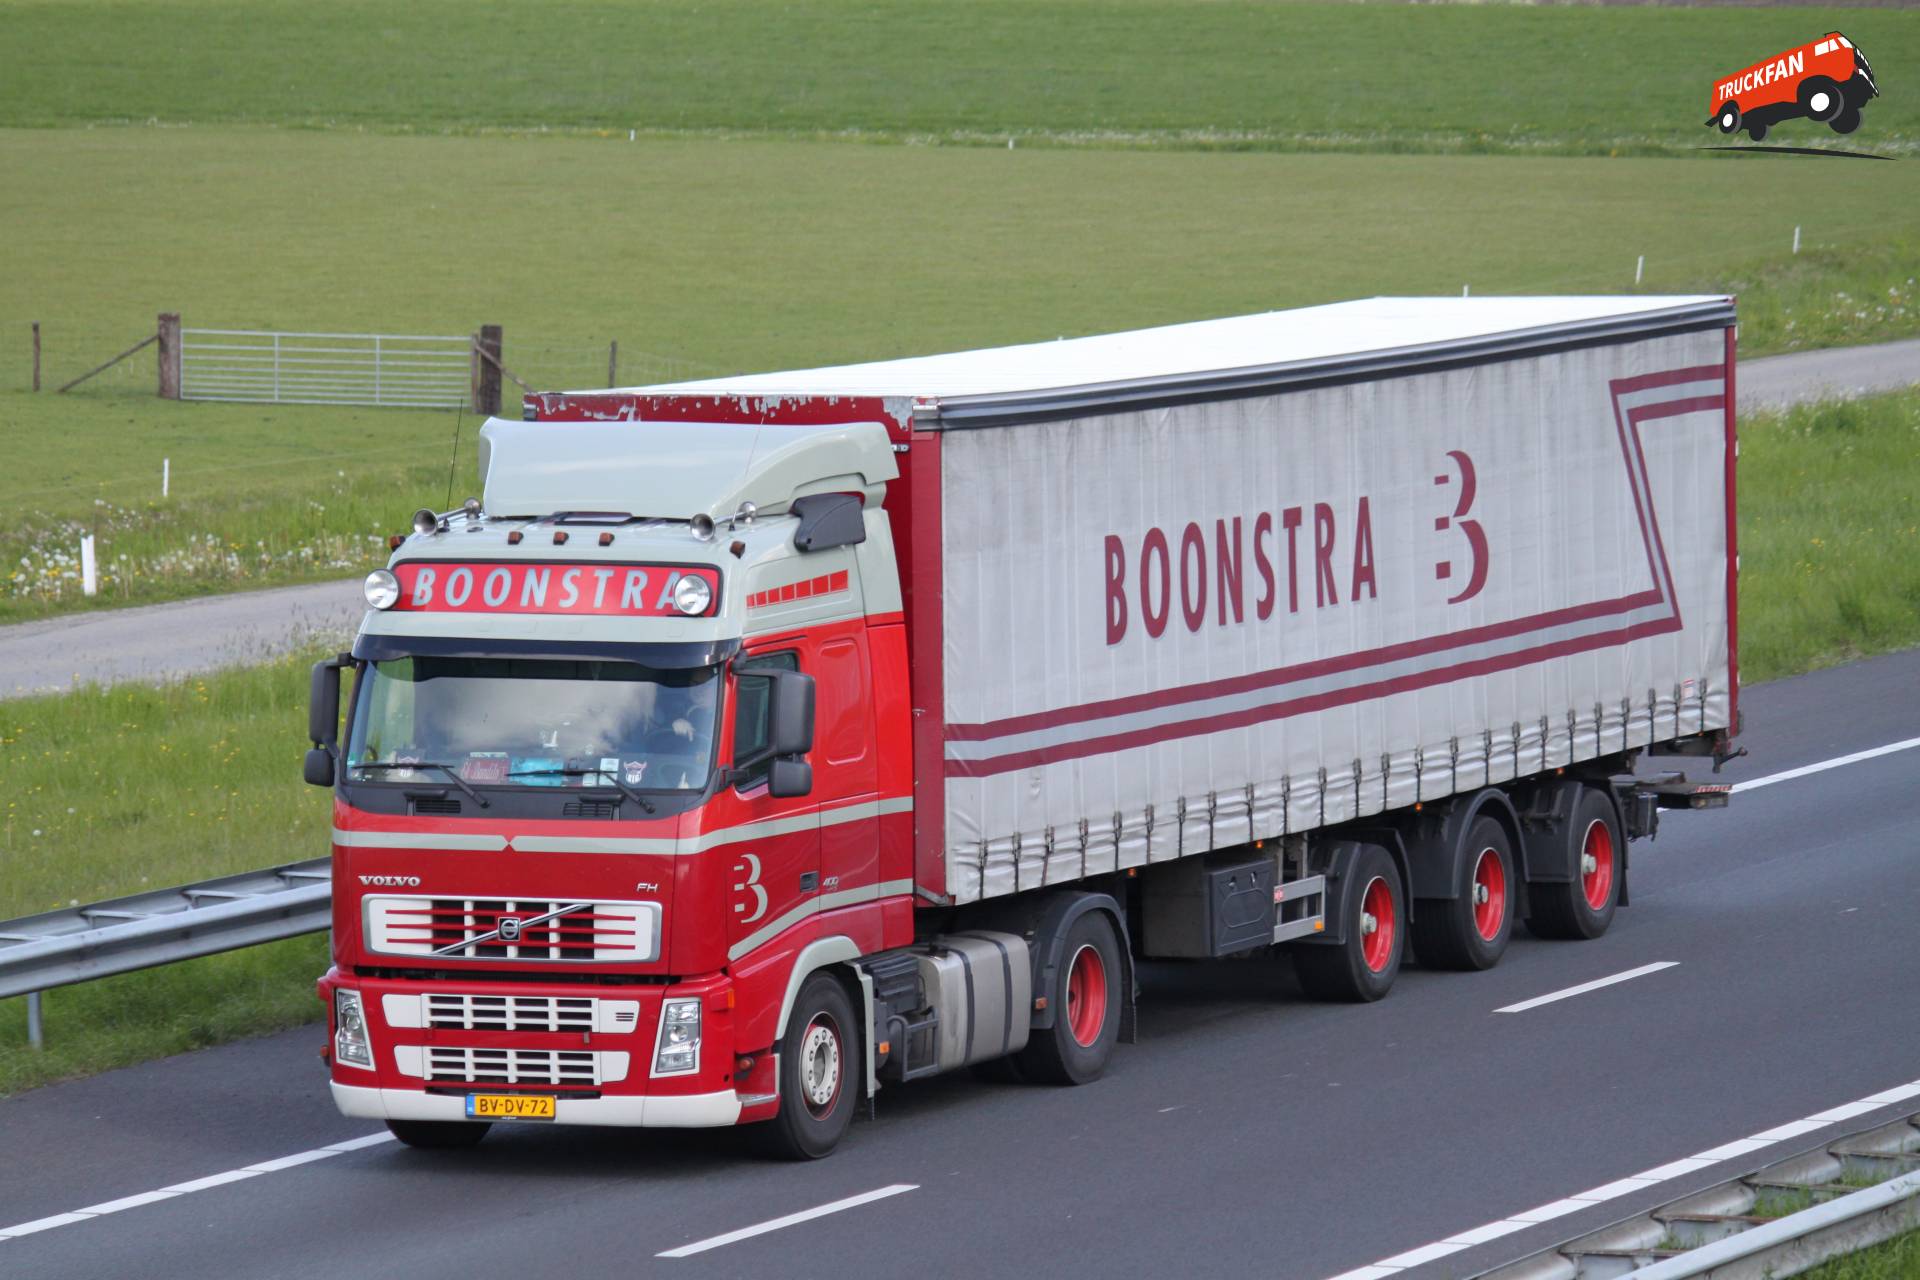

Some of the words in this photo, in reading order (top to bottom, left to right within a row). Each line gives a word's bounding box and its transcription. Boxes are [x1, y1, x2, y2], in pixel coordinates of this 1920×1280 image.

[1104, 496, 1377, 646] BOONSTRA
[411, 567, 681, 611] BOONSTRA
[358, 875, 421, 887] VOLVO
[636, 882, 658, 893] FH
[479, 1098, 548, 1114] BV-DV-72
